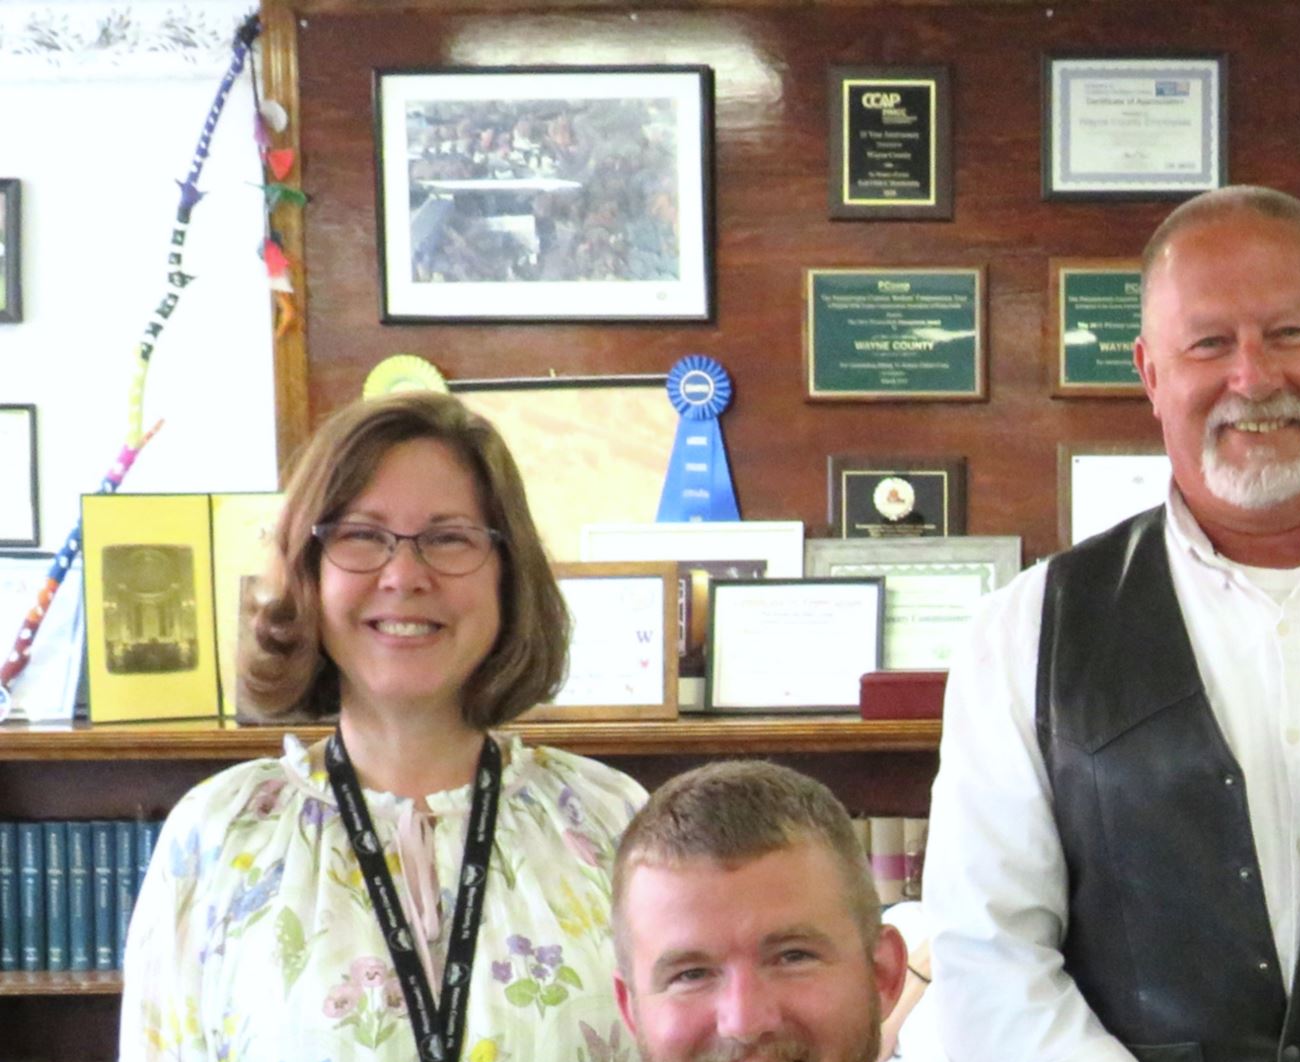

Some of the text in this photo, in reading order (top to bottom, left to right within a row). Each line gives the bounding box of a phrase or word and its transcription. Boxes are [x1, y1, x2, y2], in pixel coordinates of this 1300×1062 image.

[862, 92, 901, 109] CCAP
[854, 341, 934, 350] WAYNE COUNTY
